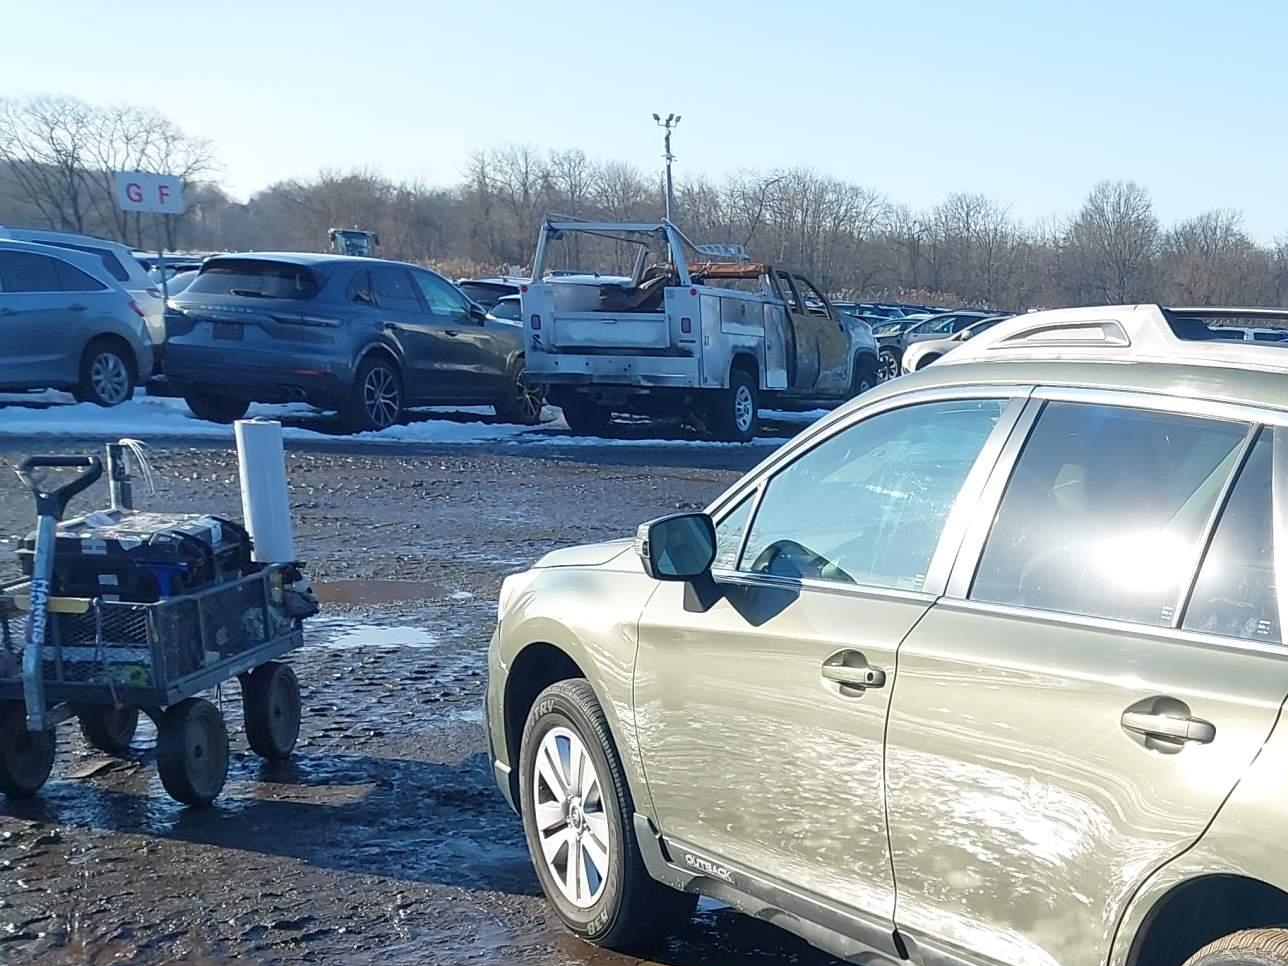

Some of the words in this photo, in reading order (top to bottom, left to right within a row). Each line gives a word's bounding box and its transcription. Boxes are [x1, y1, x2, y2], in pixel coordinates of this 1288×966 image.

[126, 183, 143, 203] G
[158, 185, 170, 204] F
[685, 854, 736, 885] OUTBACK
